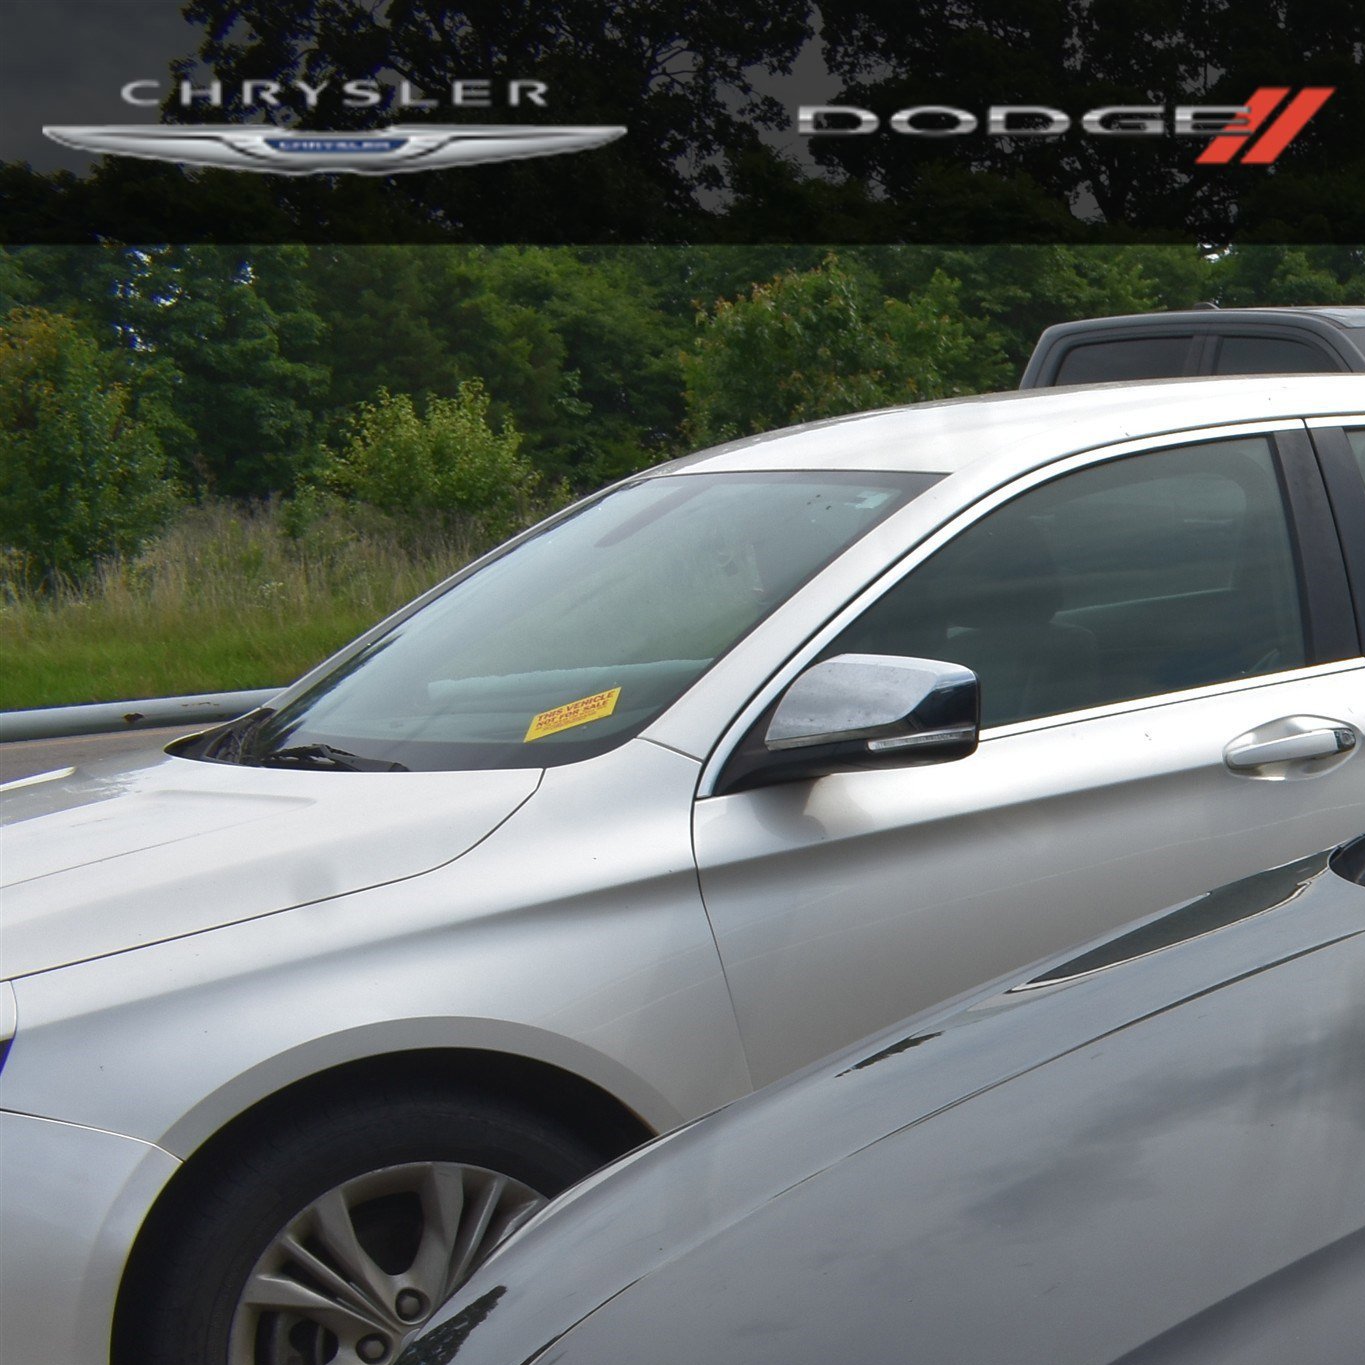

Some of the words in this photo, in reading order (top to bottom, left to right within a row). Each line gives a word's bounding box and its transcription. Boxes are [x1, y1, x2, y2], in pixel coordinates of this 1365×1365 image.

[536, 717, 556, 728] NOT
[559, 709, 580, 720] FOR
[584, 700, 609, 711] SALE
[538, 708, 563, 722] THIS
[566, 691, 615, 712] VEHICLE
